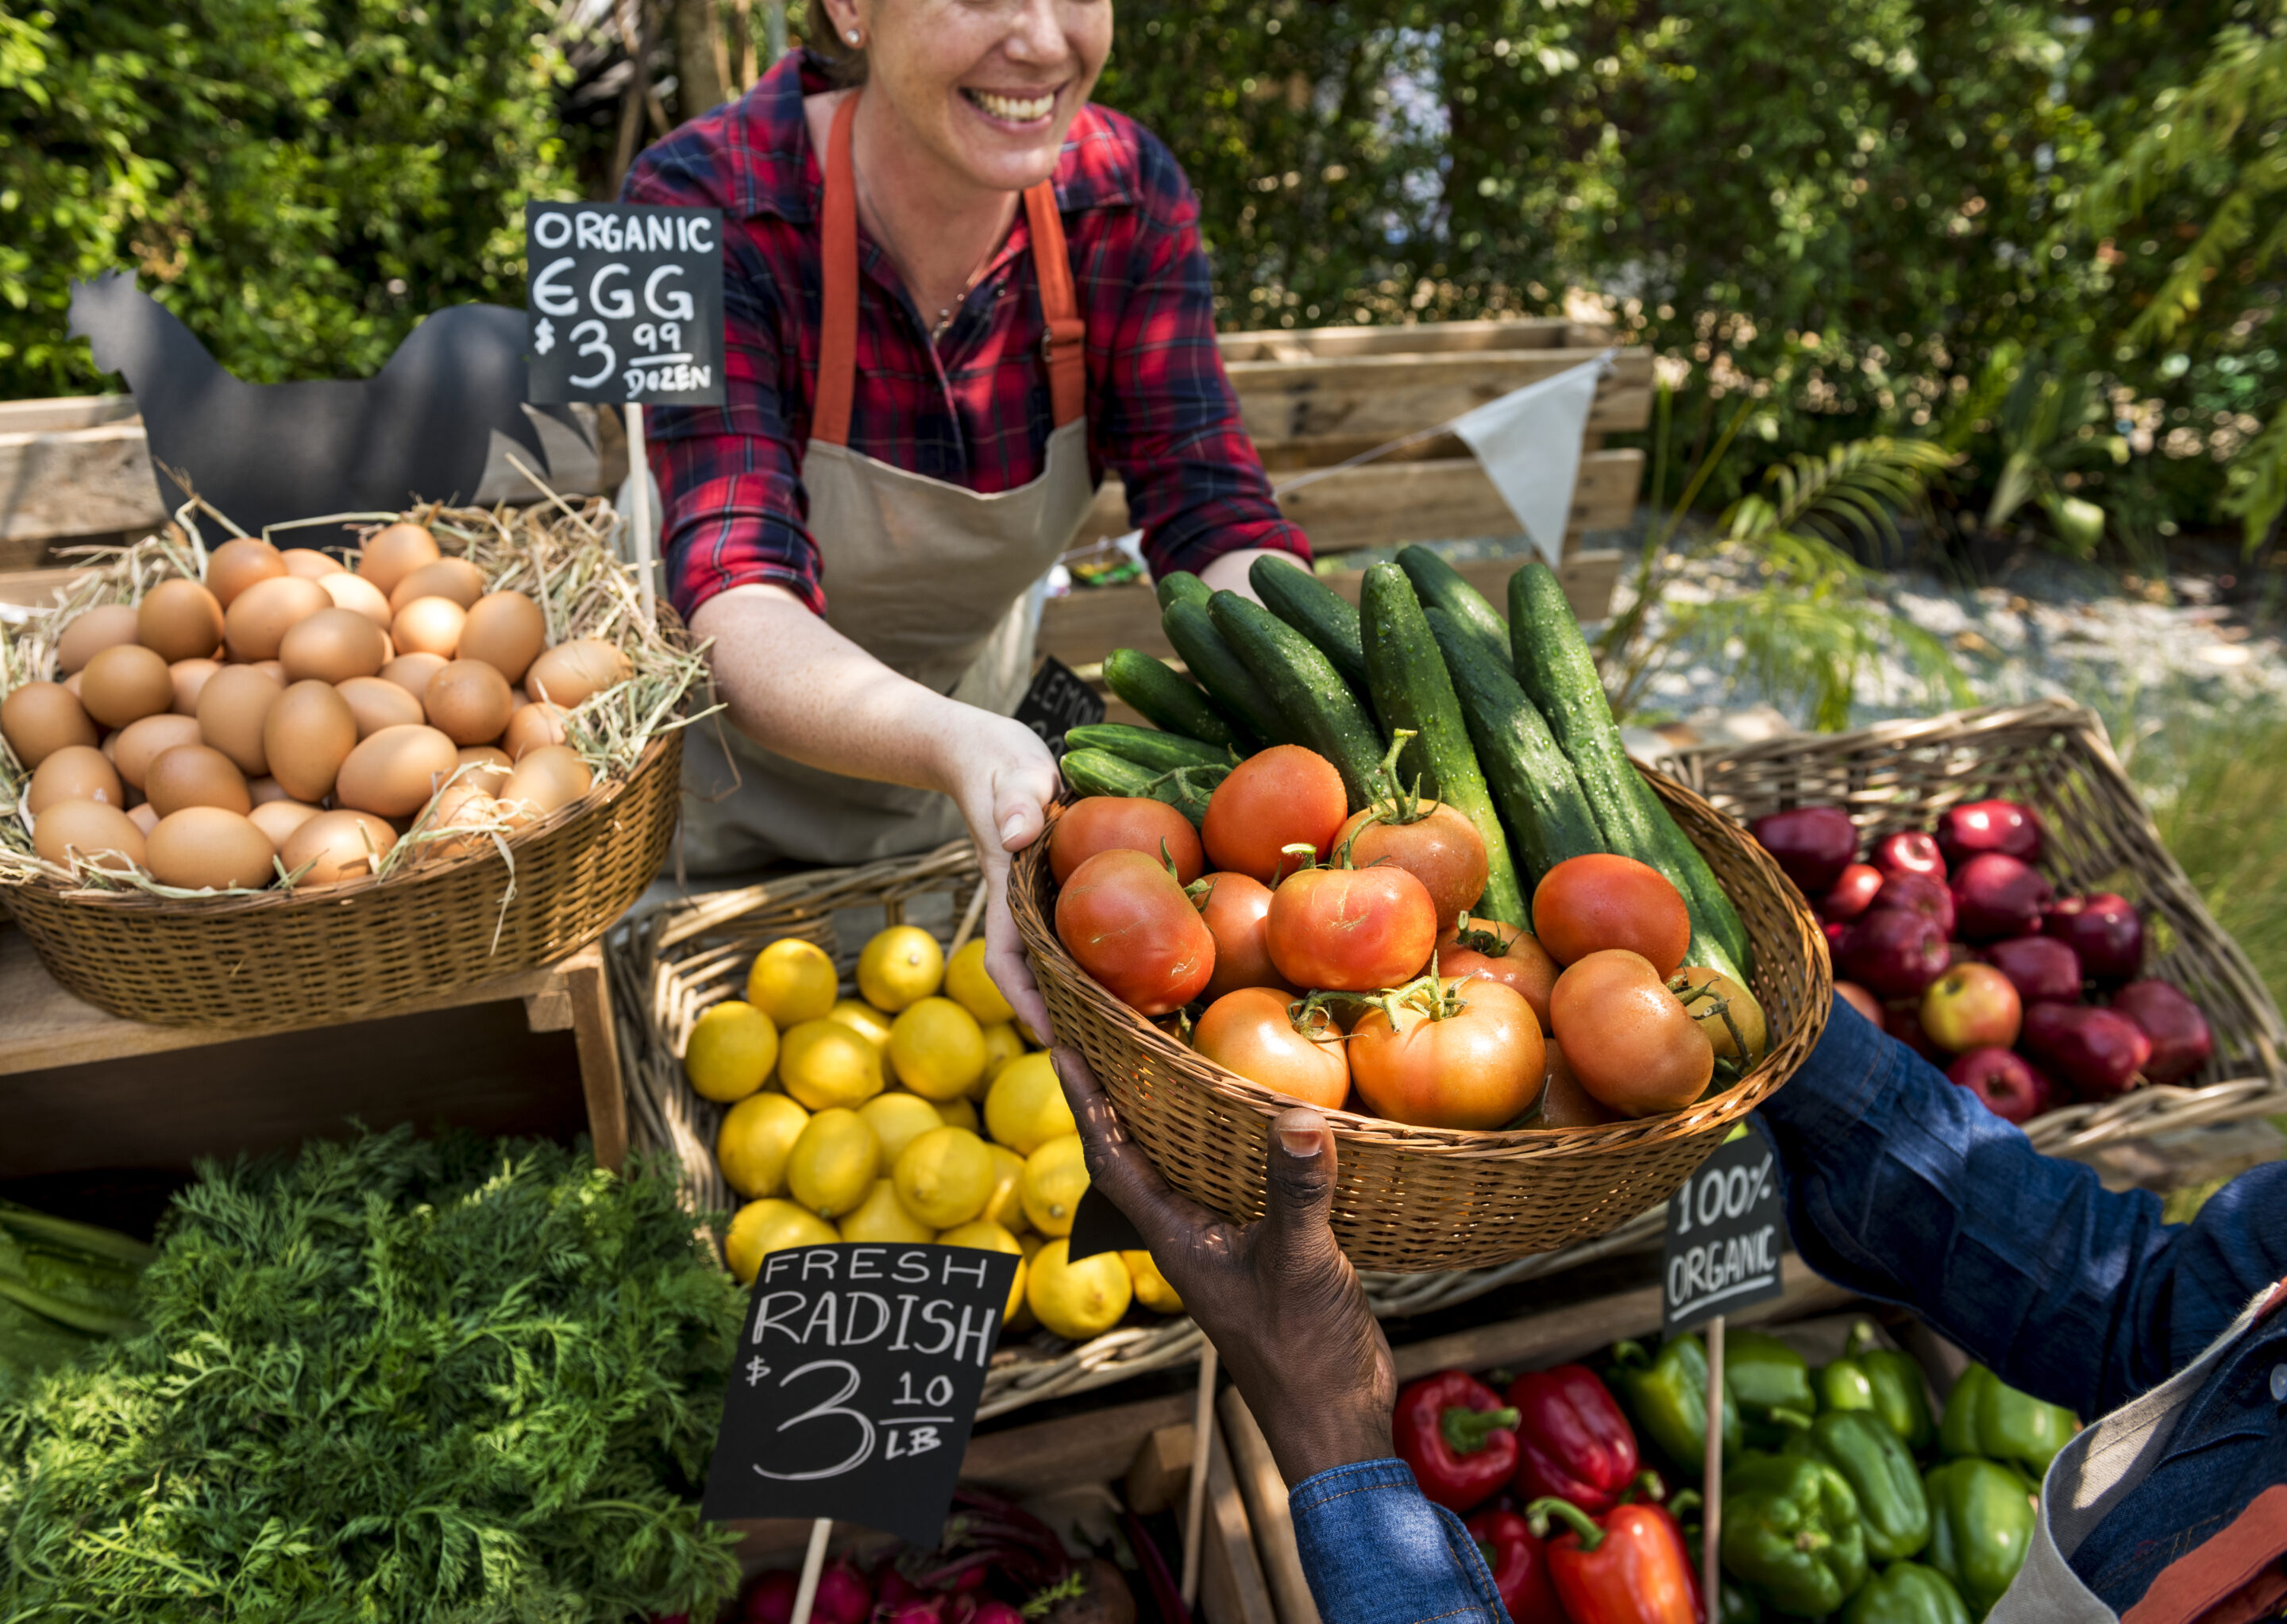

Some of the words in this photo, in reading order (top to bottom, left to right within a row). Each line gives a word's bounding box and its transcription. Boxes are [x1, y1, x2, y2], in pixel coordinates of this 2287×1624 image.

[534, 210, 714, 253] ORGANIC
[533, 257, 694, 321] EGG
[622, 364, 712, 399] DOZEN
[1676, 1152, 1773, 1235] 100%
[765, 1248, 987, 1289] FRESH
[1668, 1225, 1776, 1307] ORGANIC
[751, 1290, 996, 1367] RADISH
[885, 1425, 942, 1460] LB
